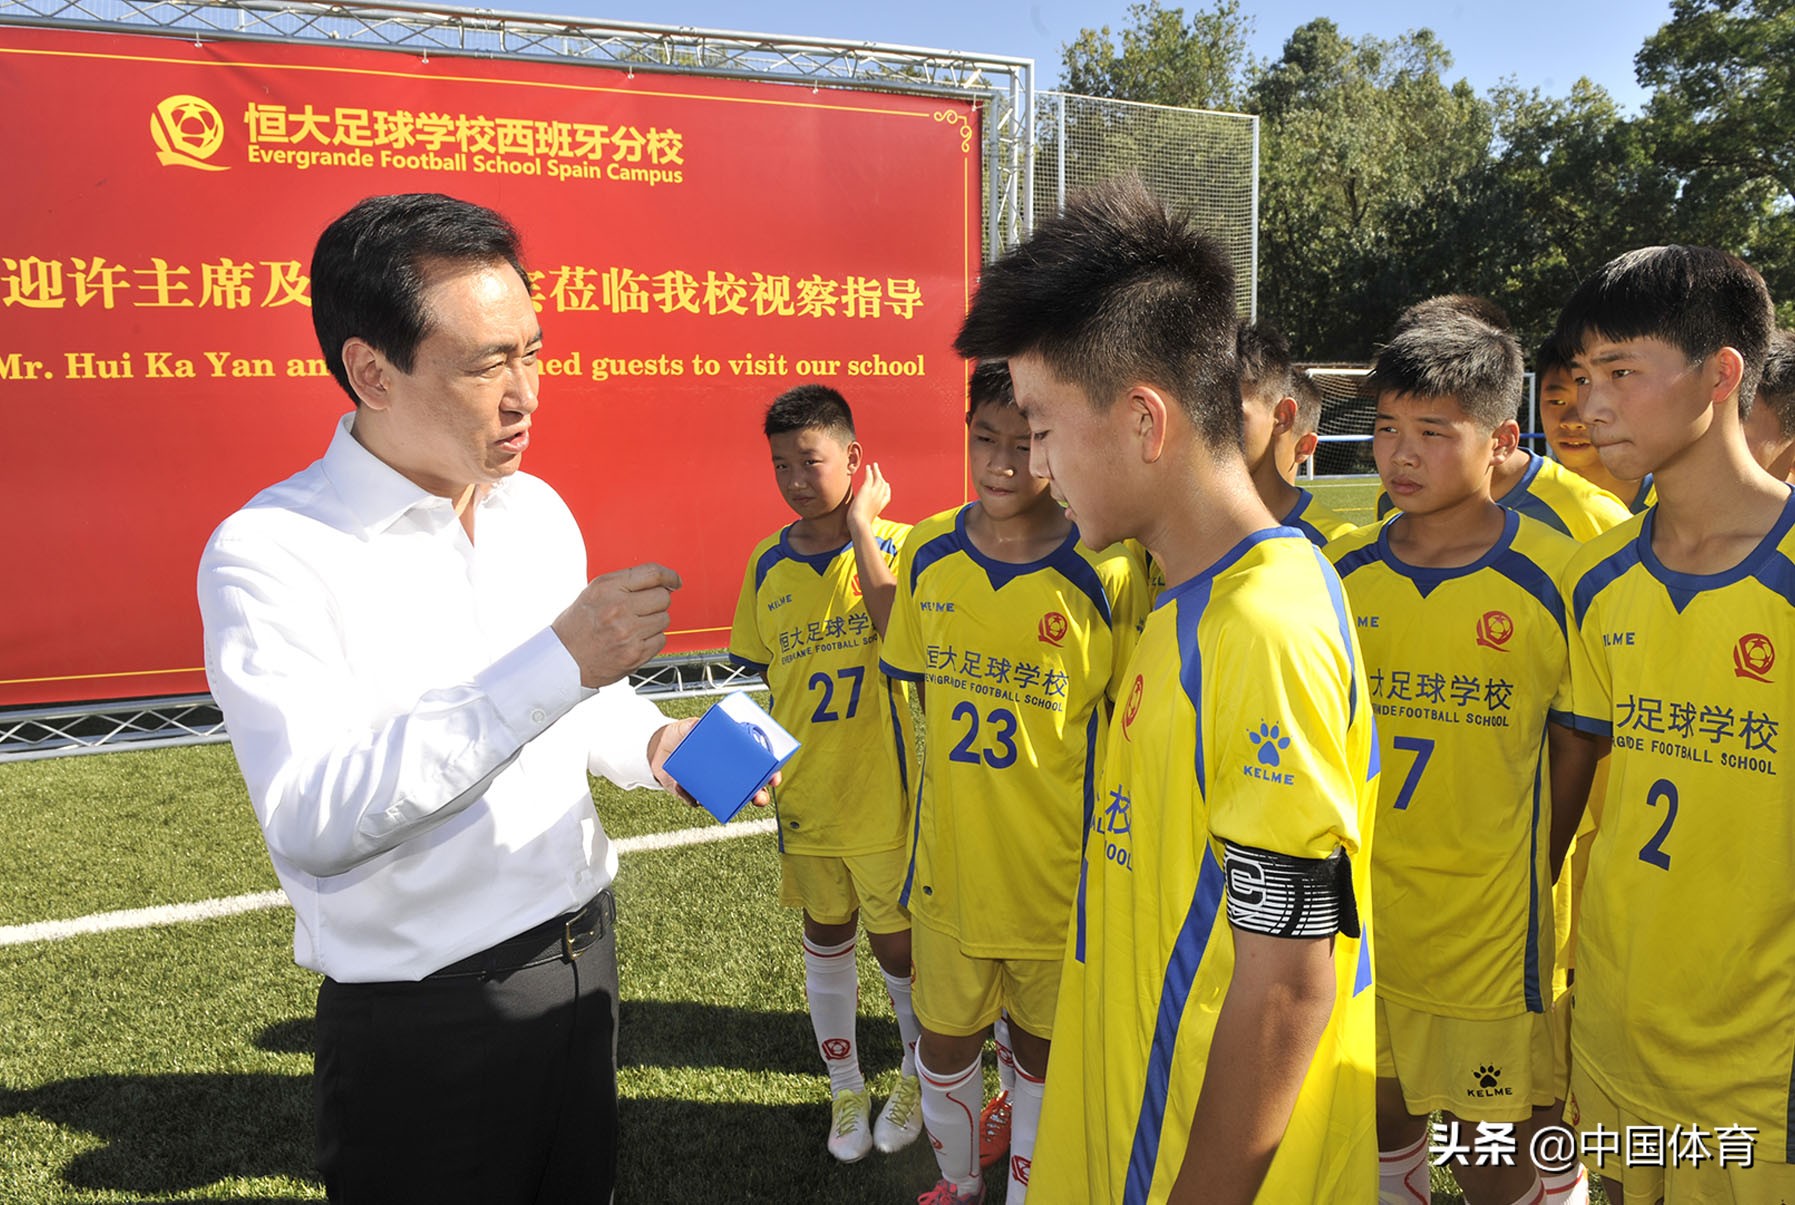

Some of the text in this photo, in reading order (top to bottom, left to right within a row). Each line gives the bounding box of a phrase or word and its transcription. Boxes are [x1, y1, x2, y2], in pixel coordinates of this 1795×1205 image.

[243, 102, 684, 166] 恒大足球学校西班牙分校
[248, 145, 683, 187] Evergrande Football School Spain Campus
[0, 255, 312, 310] 迎许主席及
[0, 353, 53, 380] Mr.
[64, 352, 133, 379] Hui
[144, 352, 196, 378] Ka
[204, 352, 275, 377] Yan
[286, 358, 330, 377] an
[592, 354, 683, 381] guests
[692, 354, 721, 376] to
[728, 353, 788, 376] visit
[796, 359, 841, 376] our
[848, 354, 926, 376] school
[779, 612, 876, 653] 恒大足球学
[808, 665, 866, 723] 27
[970, 683, 1020, 702] FOOTBALL
[1024, 694, 1063, 712] SCHOOL
[949, 700, 1018, 769] 23
[1399, 705, 1460, 723] FOOTBALL
[1466, 713, 1510, 727] SCHOOL
[1243, 765, 1295, 786] KELME
[1393, 735, 1435, 810] 7
[1651, 740, 1714, 764] FOOTBALL
[1721, 752, 1777, 776] SCHOOL
[1638, 778, 1679, 872] 2
[1467, 1087, 1513, 1098] KELME
